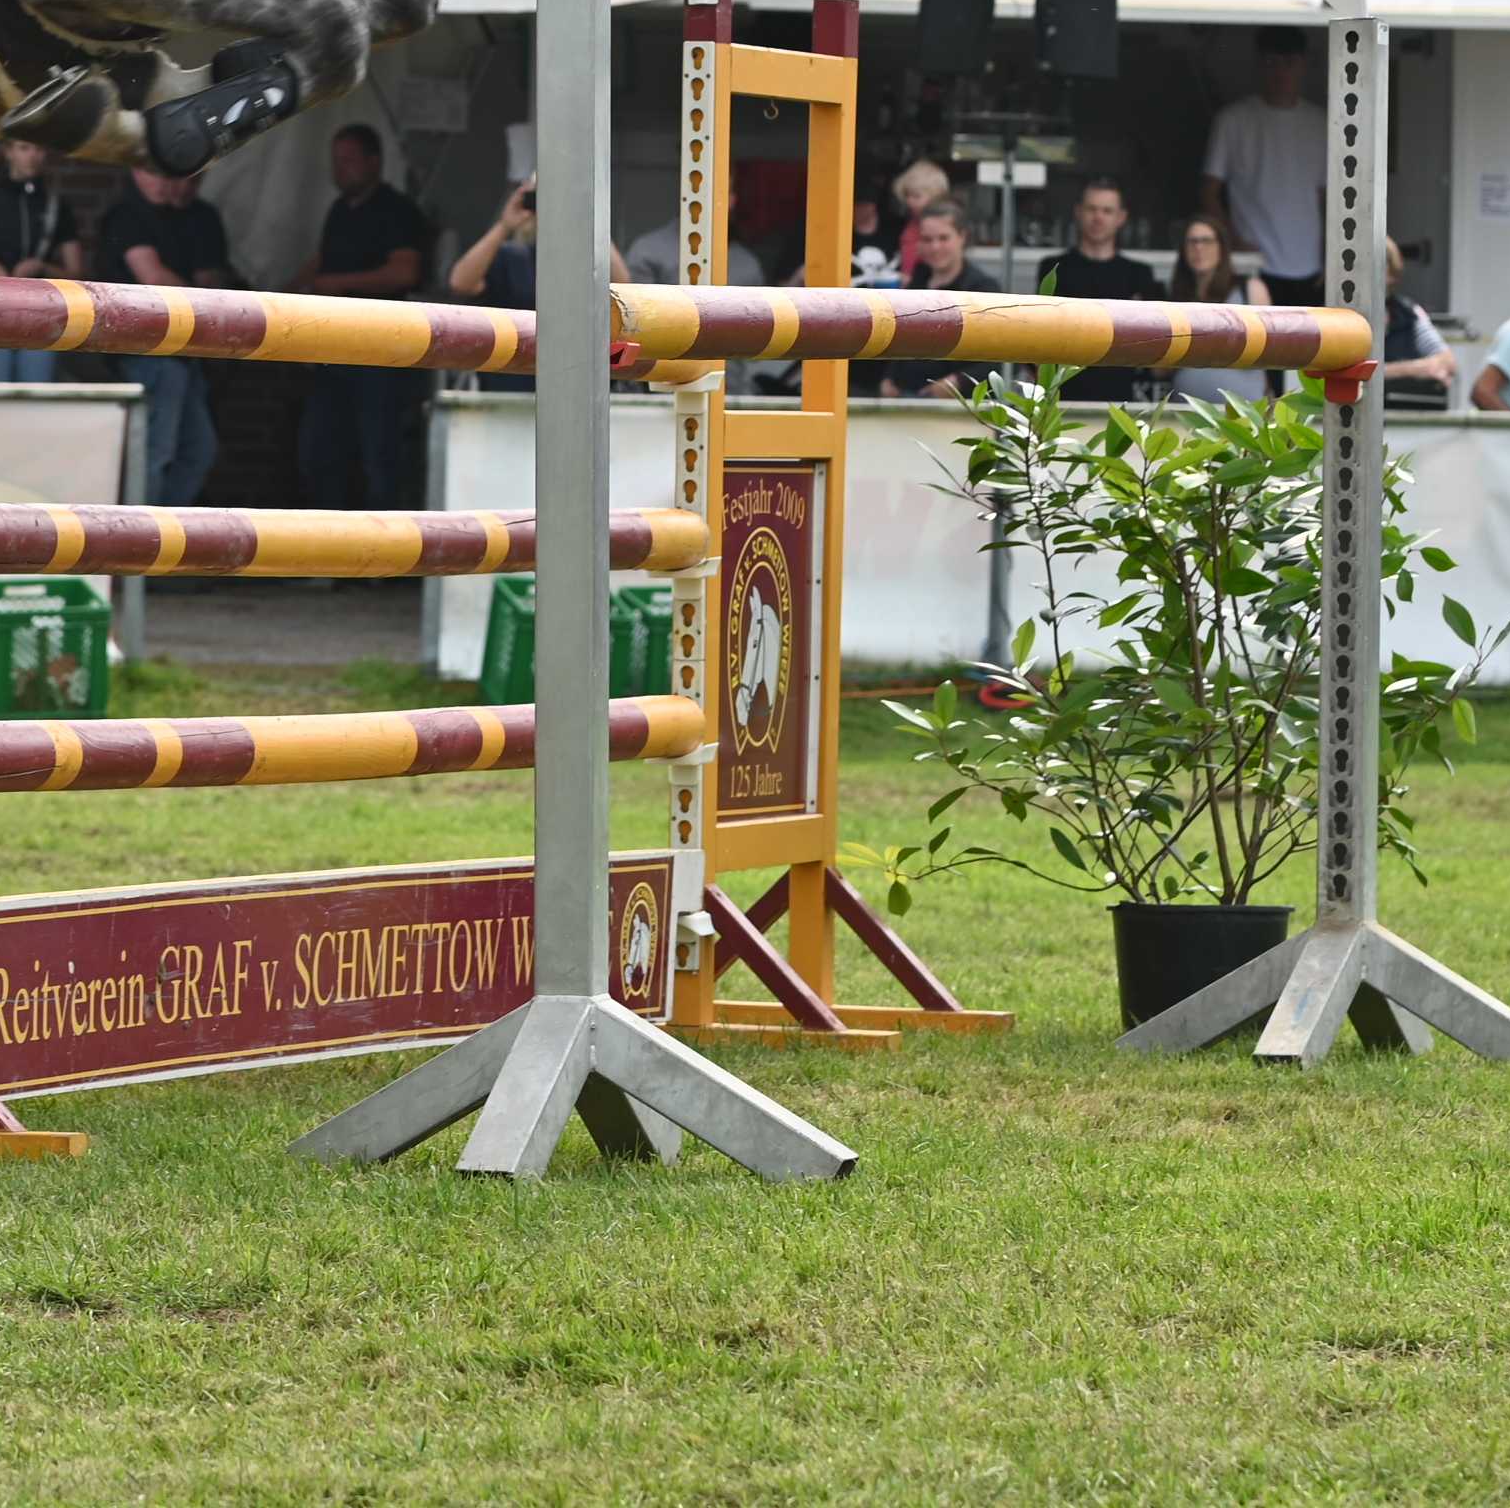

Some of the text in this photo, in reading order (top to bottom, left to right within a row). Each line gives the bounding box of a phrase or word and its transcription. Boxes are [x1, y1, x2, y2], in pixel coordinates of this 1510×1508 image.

[723, 478, 806, 531] Festjahr 2009
[778, 623, 791, 696] WEEZE
[731, 763, 783, 799] 125 Jahre
[155, 939, 253, 1024] GRAF
[260, 960, 283, 1013] v.
[293, 918, 505, 1010] SCHMETTOW
